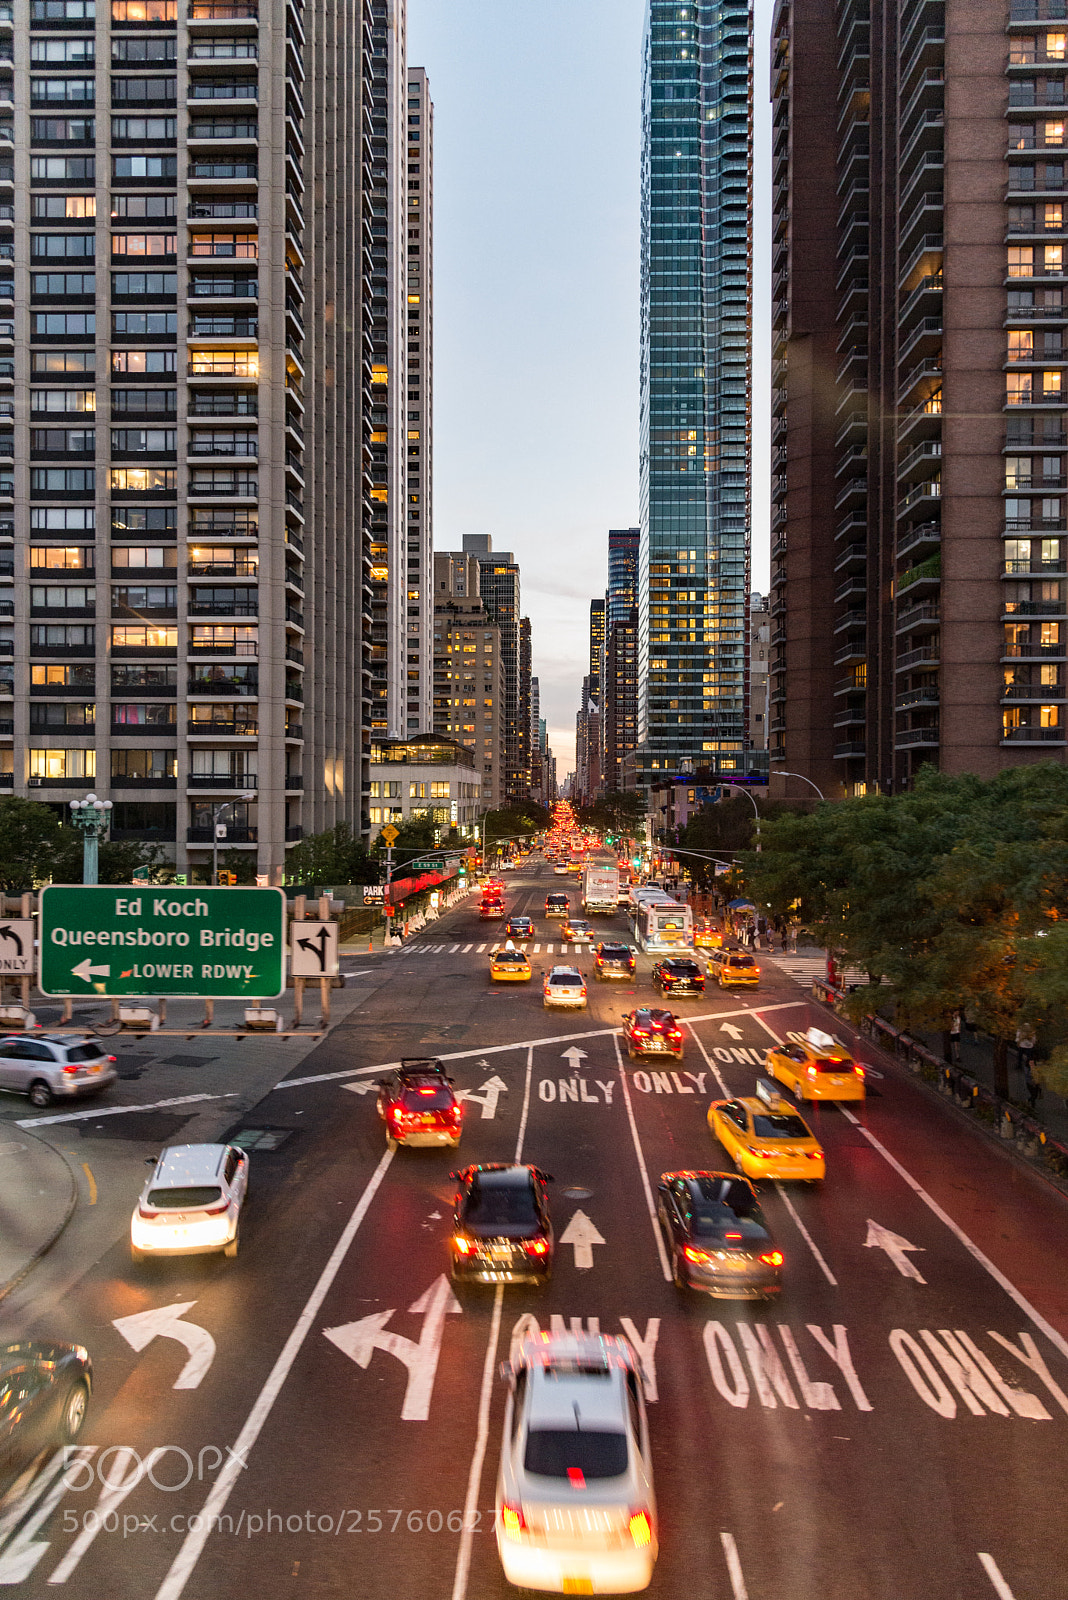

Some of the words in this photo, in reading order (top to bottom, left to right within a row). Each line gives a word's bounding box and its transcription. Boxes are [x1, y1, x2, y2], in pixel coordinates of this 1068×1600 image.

[363, 886, 384, 896] PARK
[115, 898, 142, 916] Ed
[153, 898, 209, 916] Koch
[50, 927, 190, 947] Queensboro
[200, 929, 274, 951] Bridge
[0, 959, 28, 970] NLY
[132, 964, 193, 979] LOWER
[201, 965, 253, 979] RDWY
[538, 1079, 616, 1105] ONLY
[632, 1071, 708, 1094] ONLY
[702, 1320, 875, 1411] ONLY
[888, 1328, 1068, 1419] ONLY
